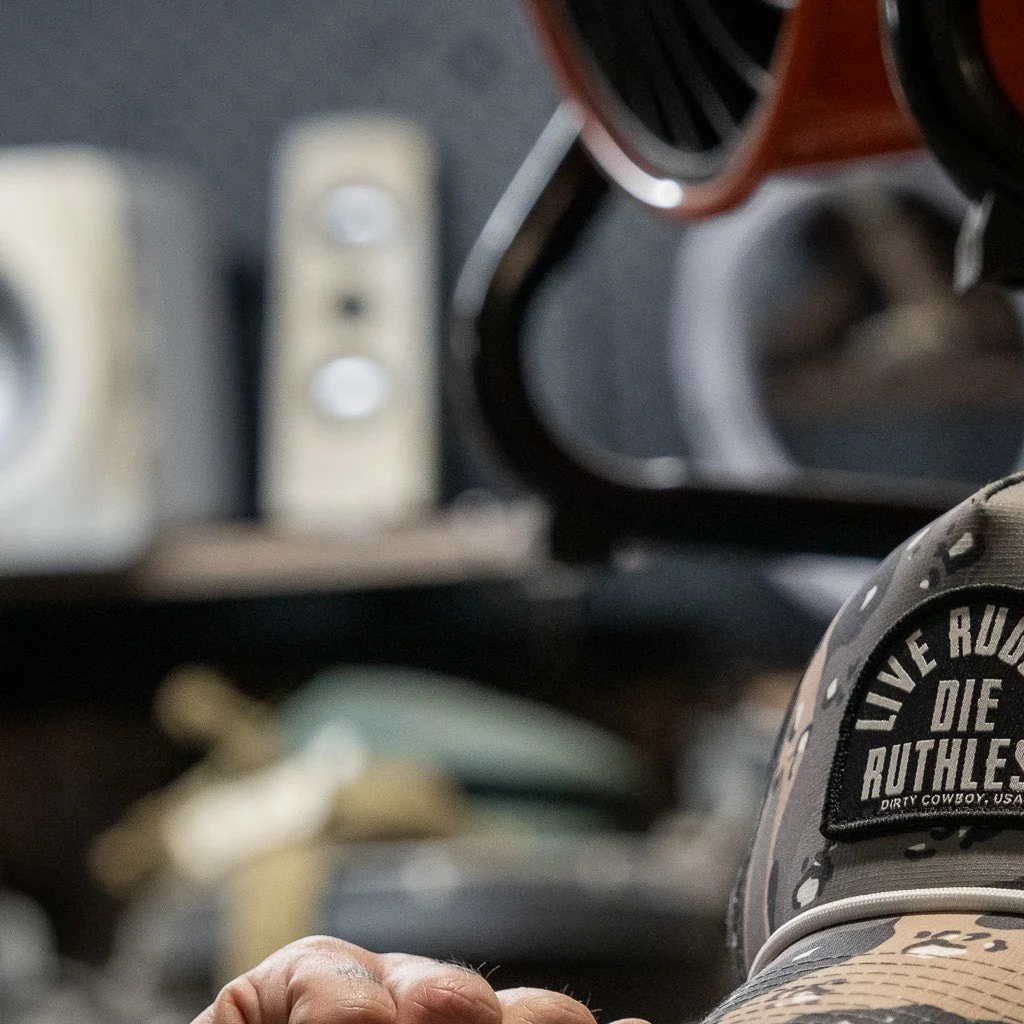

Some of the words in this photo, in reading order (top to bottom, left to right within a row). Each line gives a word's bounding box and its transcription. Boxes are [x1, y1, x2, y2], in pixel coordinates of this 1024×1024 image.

[855, 629, 937, 731] LIVE
[930, 678, 1003, 732] DIE
[880, 795, 917, 810] DIRTY
[994, 793, 1024, 805] USA
